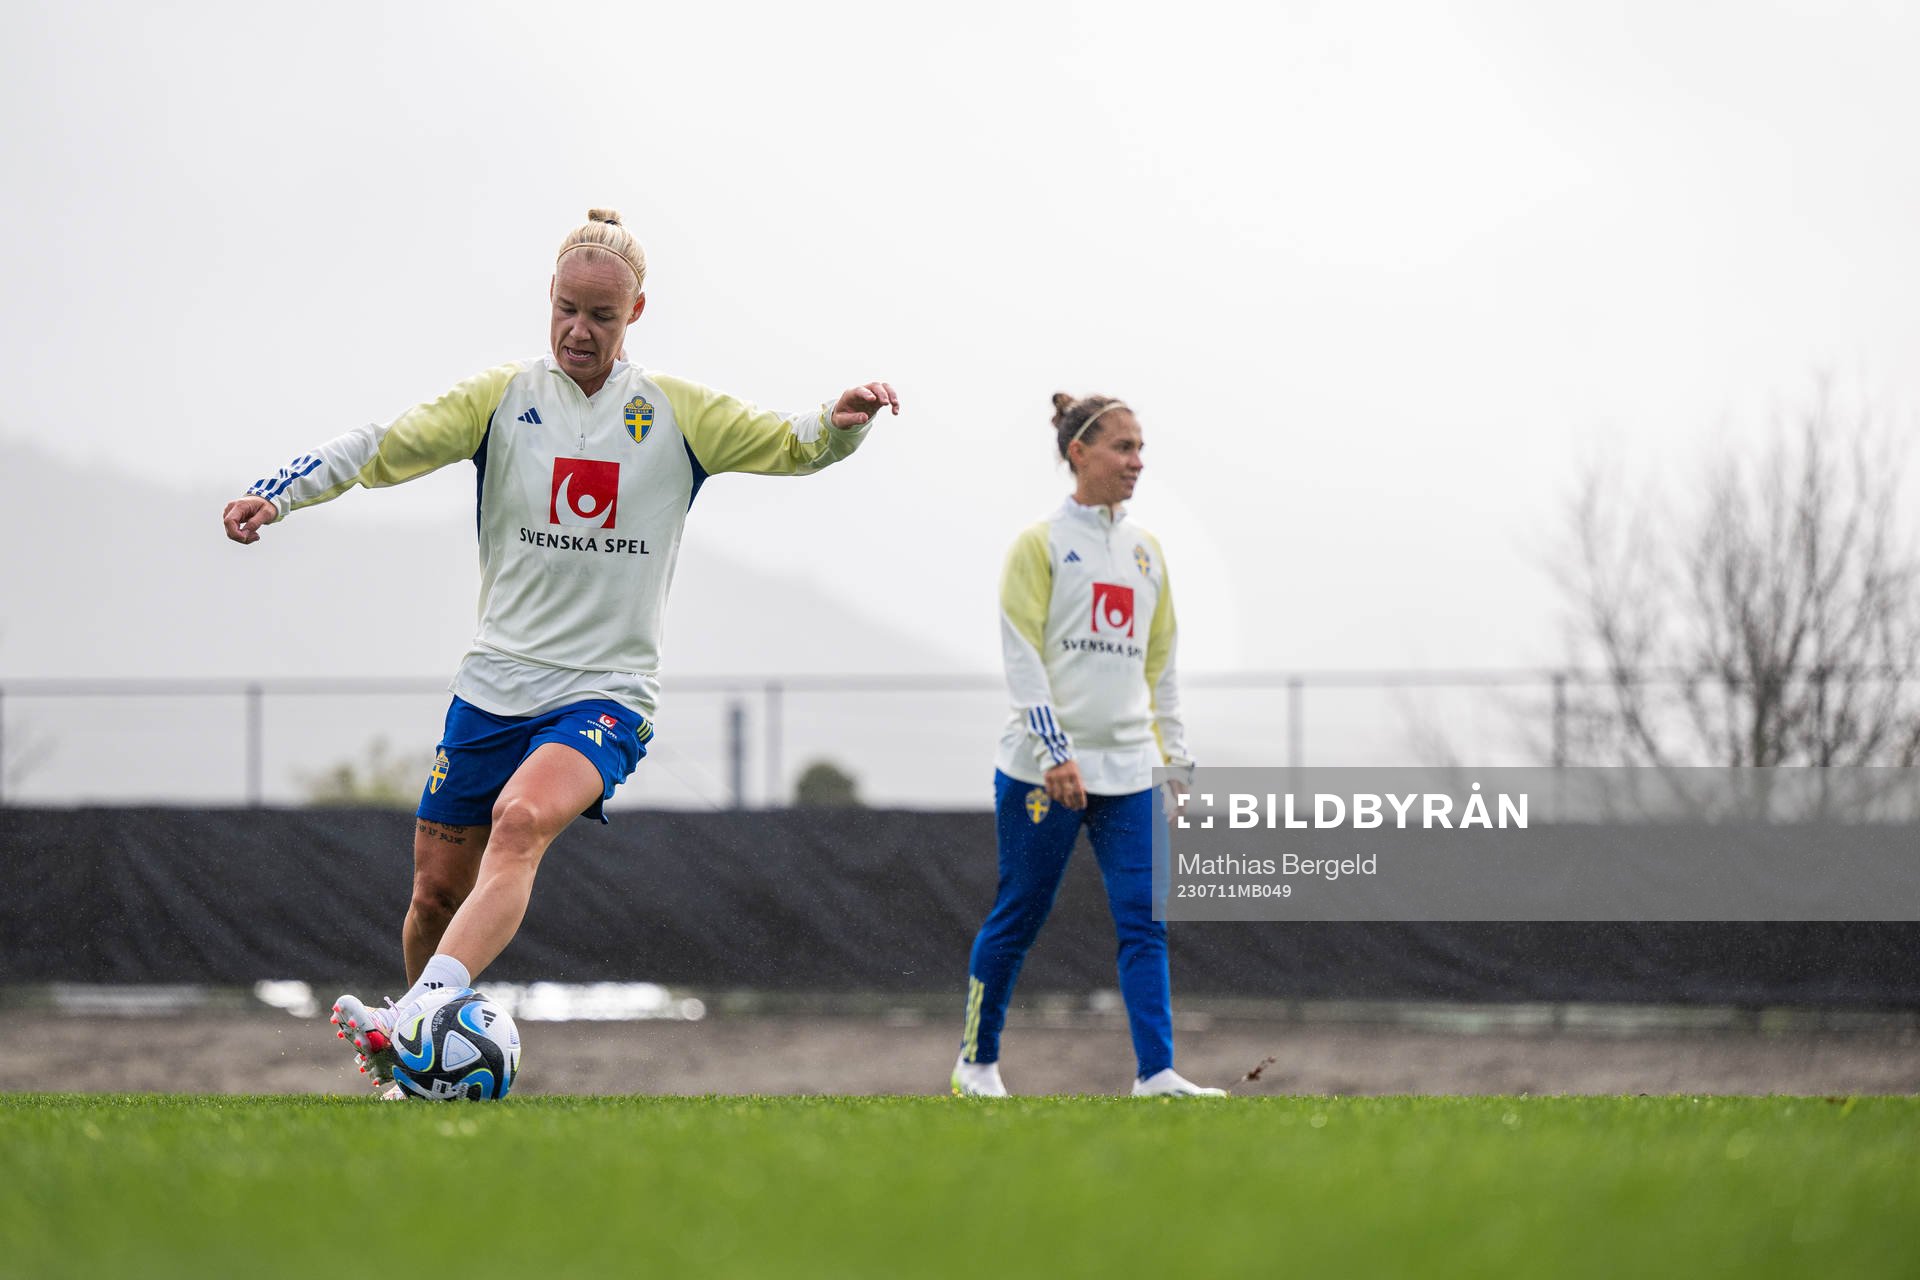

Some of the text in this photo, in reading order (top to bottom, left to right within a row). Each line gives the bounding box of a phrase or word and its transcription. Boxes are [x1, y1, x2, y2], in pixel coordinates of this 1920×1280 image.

[520, 528, 649, 554] SVENSKA SPEL
[1062, 639, 1123, 654] SVENSKA
